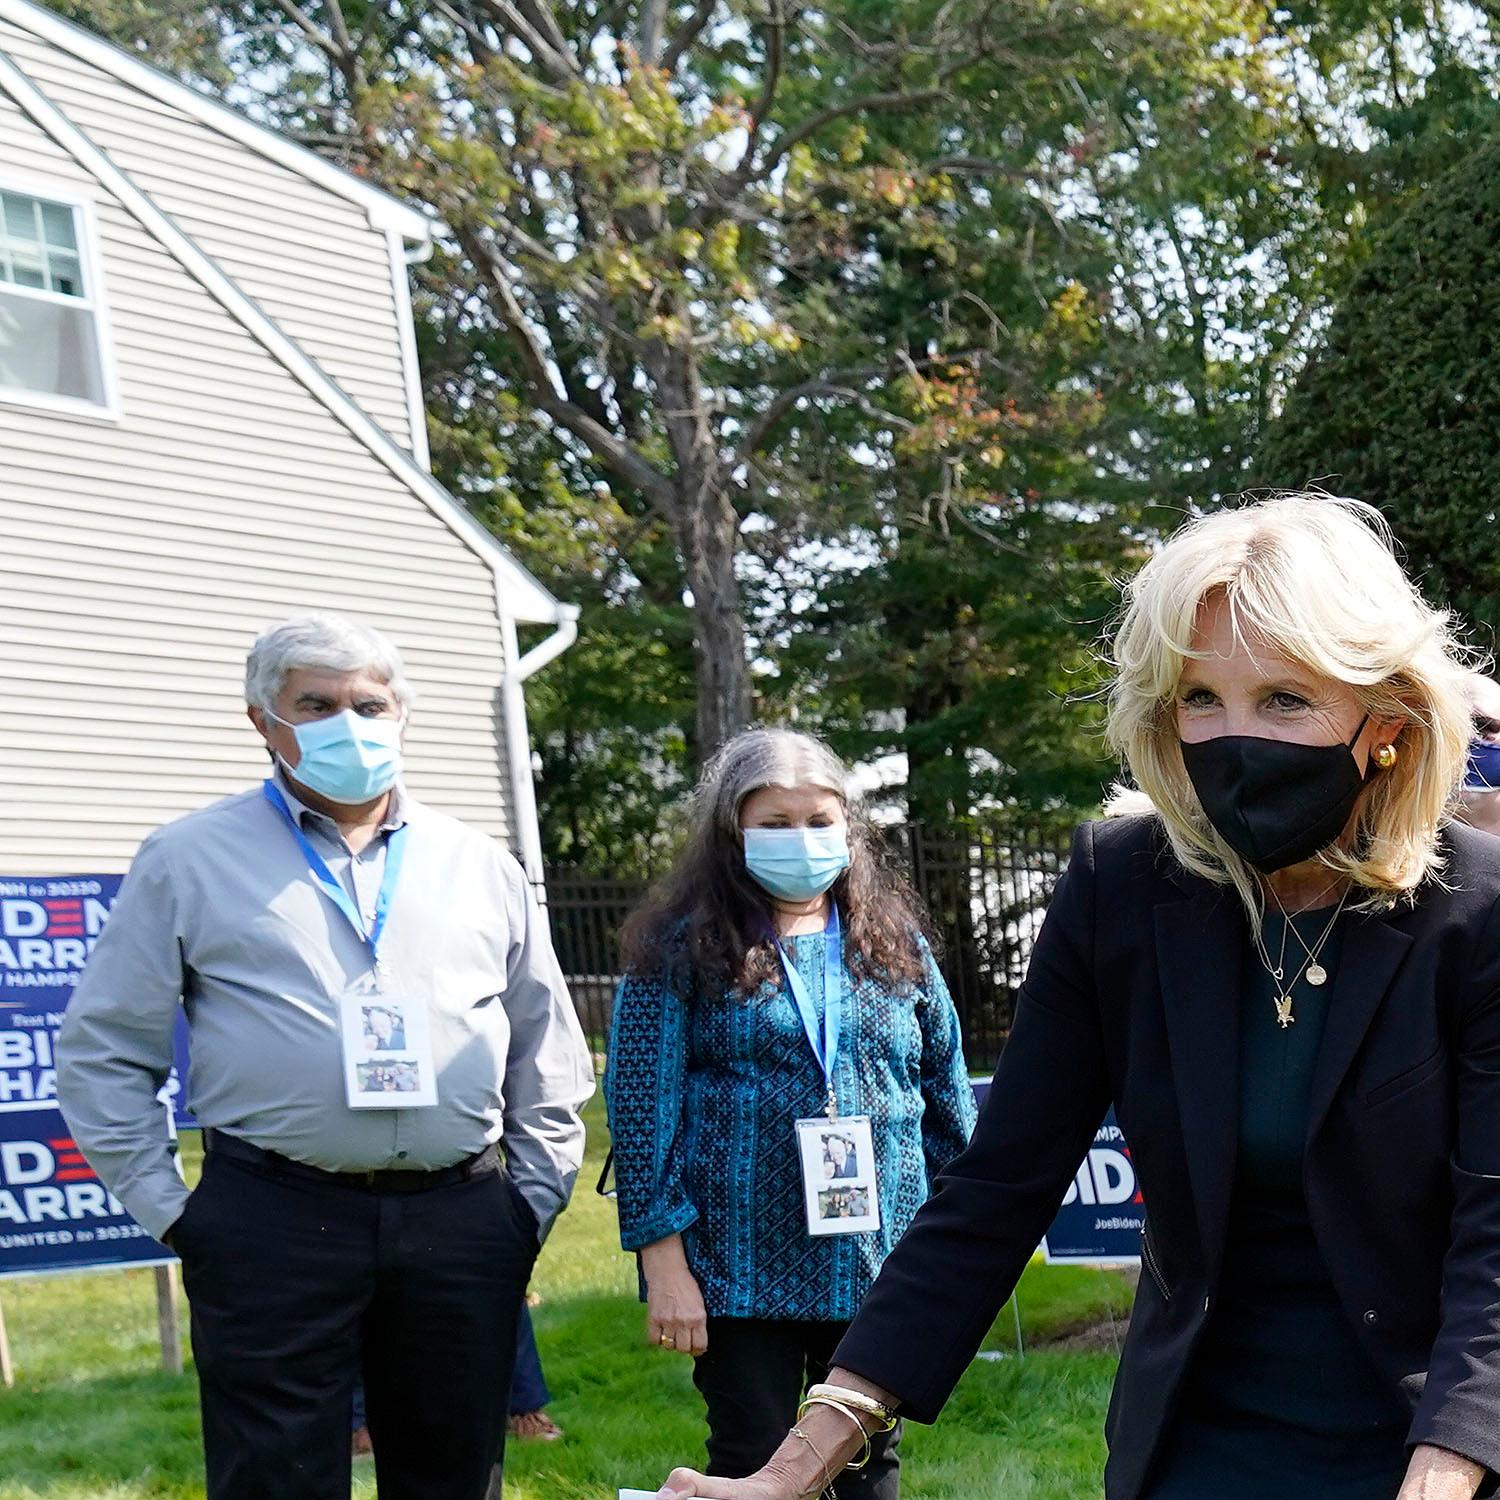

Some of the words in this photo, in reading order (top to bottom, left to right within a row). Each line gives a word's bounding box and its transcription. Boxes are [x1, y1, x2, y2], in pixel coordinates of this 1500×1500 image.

[46, 880, 102, 897] 30330
[0, 1229, 74, 1249] UNITED
[76, 1230, 95, 1243] to
